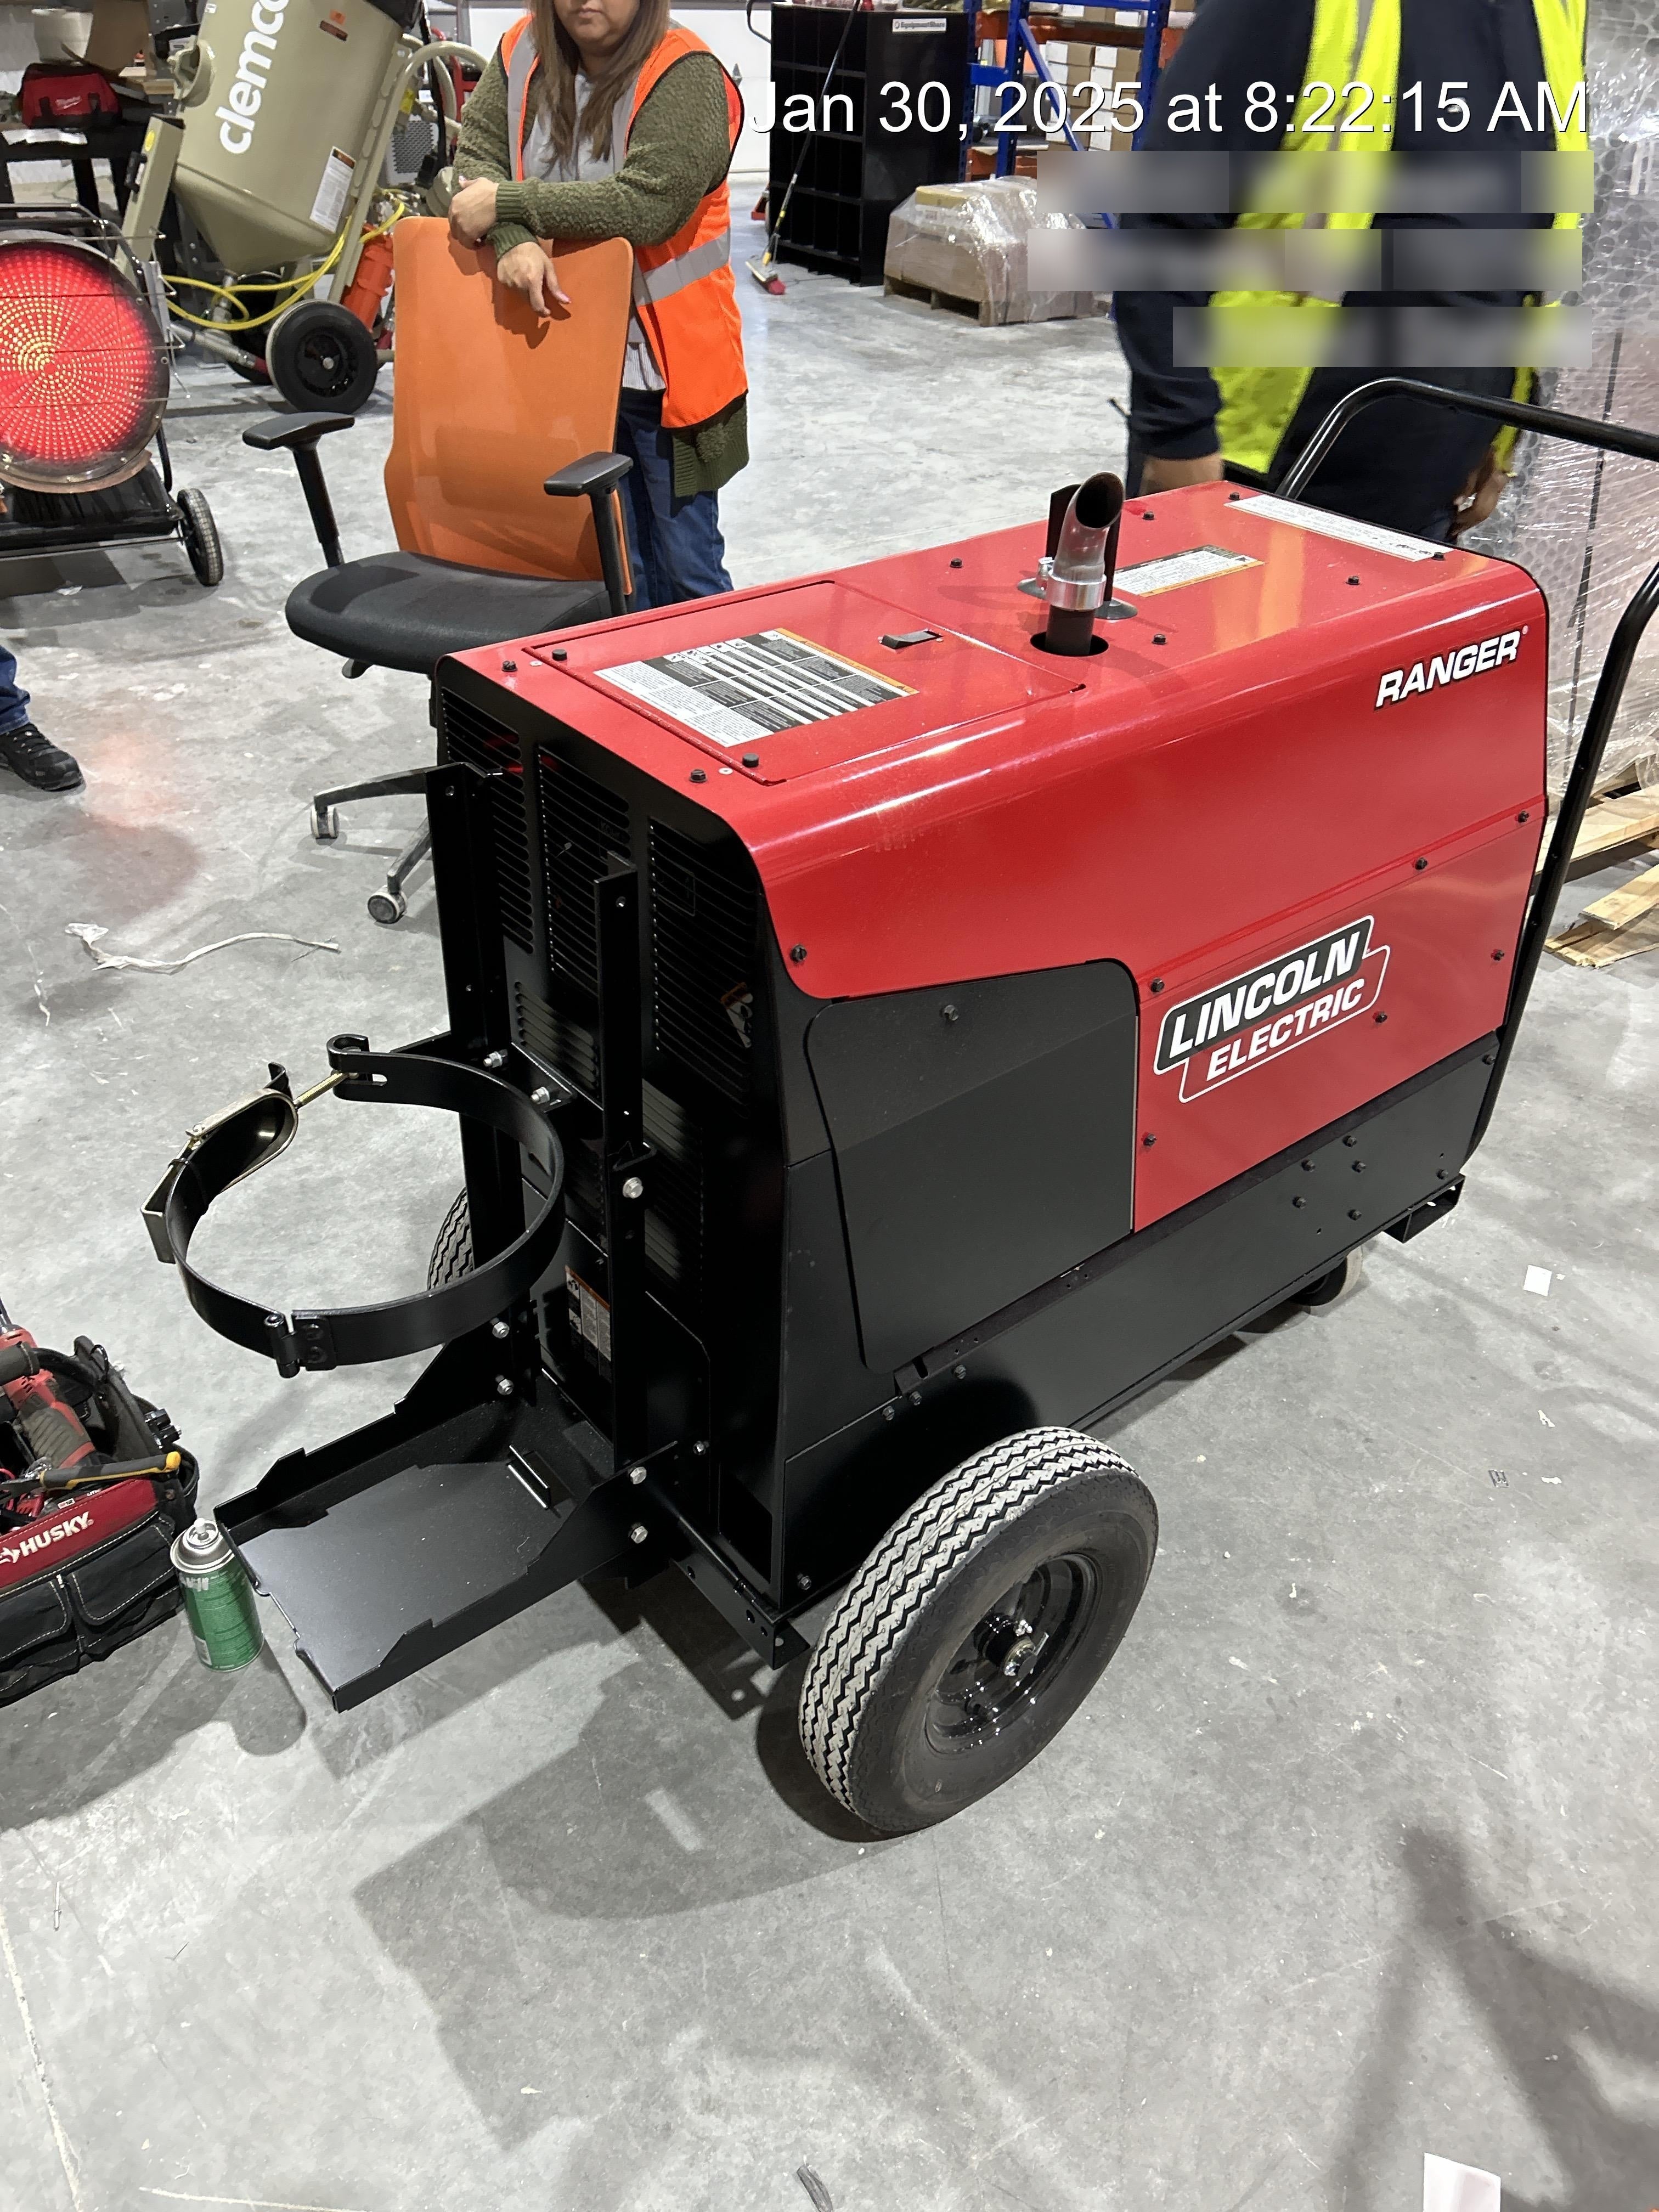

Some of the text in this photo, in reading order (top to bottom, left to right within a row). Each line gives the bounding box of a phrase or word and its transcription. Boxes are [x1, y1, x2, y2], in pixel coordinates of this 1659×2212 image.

[1375, 630, 1521, 708] RANGER
[1169, 931, 1361, 1059] LINCOLN
[1206, 978, 1365, 1081] ELECTRIC
[19, 1511, 89, 1558] HUSKY
